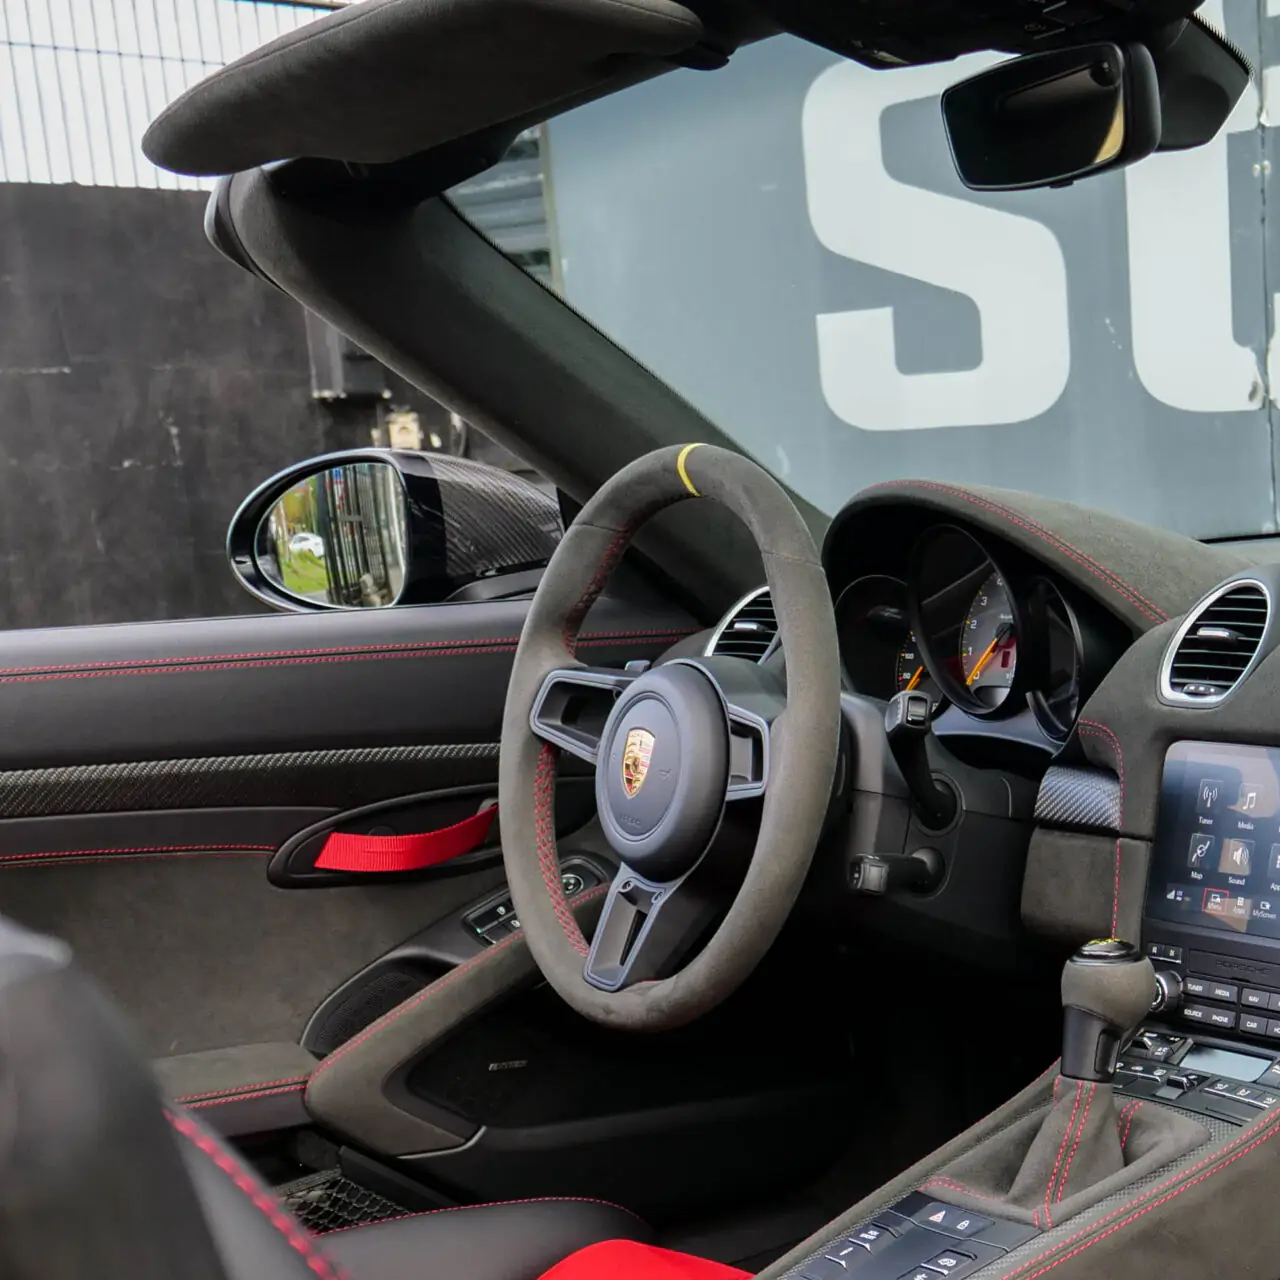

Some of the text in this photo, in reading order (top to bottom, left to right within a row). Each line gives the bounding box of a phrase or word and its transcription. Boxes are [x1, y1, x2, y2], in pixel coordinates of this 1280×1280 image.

[980, 596, 989, 606] 3
[970, 620, 978, 629] 2
[1238, 820, 1254, 831] Media
[1191, 871, 1204, 881] Map
[1228, 876, 1246, 887] Sound
[1215, 988, 1231, 998] MEDIA
[1248, 995, 1260, 1003] NAV
[1184, 1008, 1229, 1024] SOURCE PHONE
[1246, 1020, 1258, 1029] CAR
